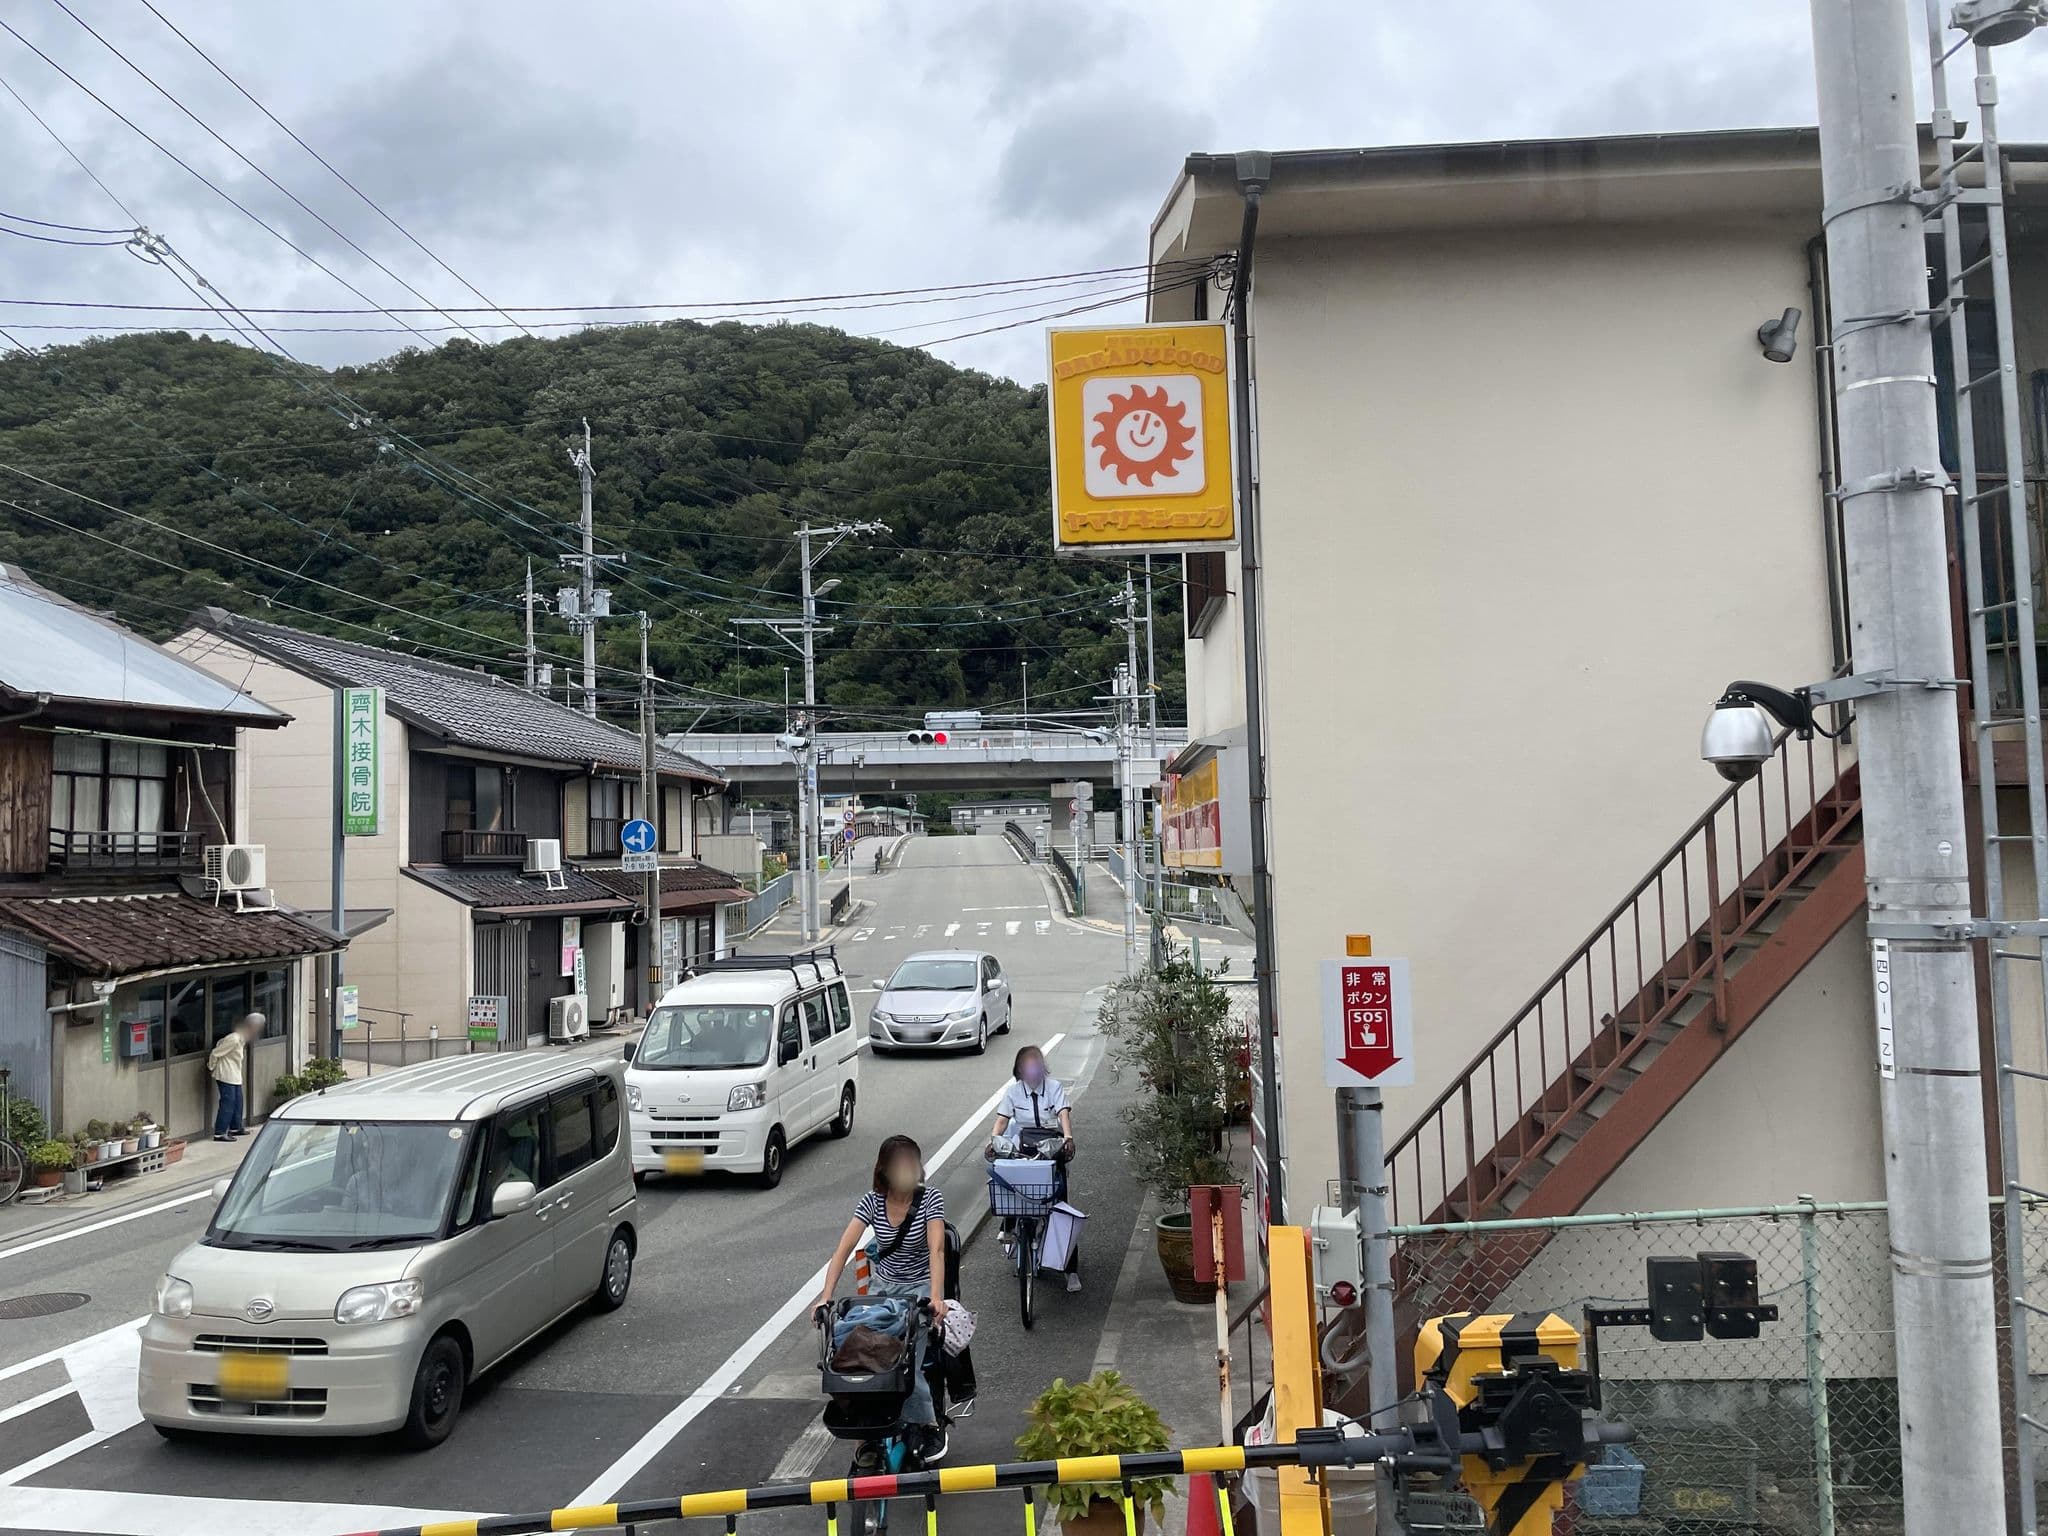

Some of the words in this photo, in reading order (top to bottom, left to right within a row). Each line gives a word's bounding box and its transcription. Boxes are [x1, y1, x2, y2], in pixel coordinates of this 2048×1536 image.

[351, 694, 372, 812] 齊木接骨院
[1346, 971, 1387, 987] 非常
[1347, 991, 1387, 1005] ボタン
[1353, 1011, 1383, 1024] SOS
